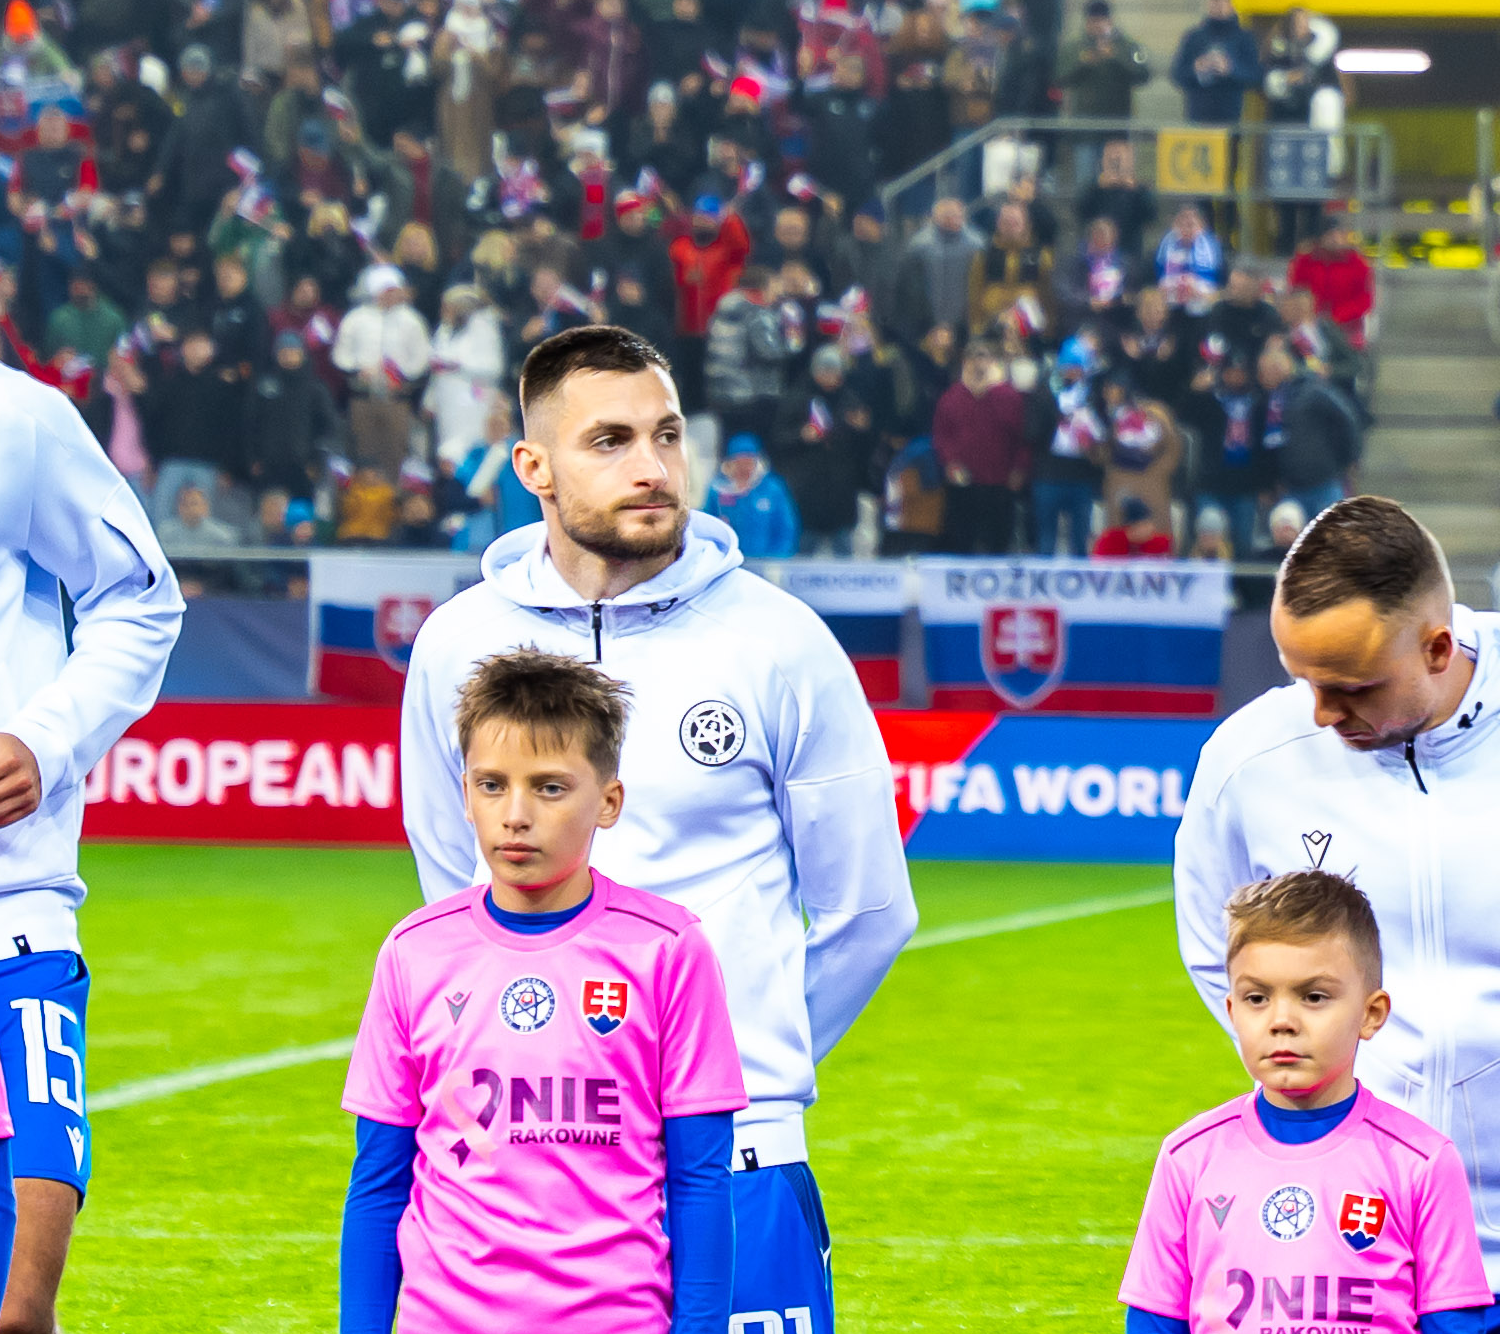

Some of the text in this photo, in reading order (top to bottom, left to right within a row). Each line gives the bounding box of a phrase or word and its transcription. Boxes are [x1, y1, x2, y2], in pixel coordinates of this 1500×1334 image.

[1012, 763, 1186, 817] WORL
[10, 998, 85, 1116] 15
[509, 1076, 622, 1125] NIE
[509, 1128, 621, 1147] RAKOVINE
[1261, 1275, 1375, 1323] NIE
